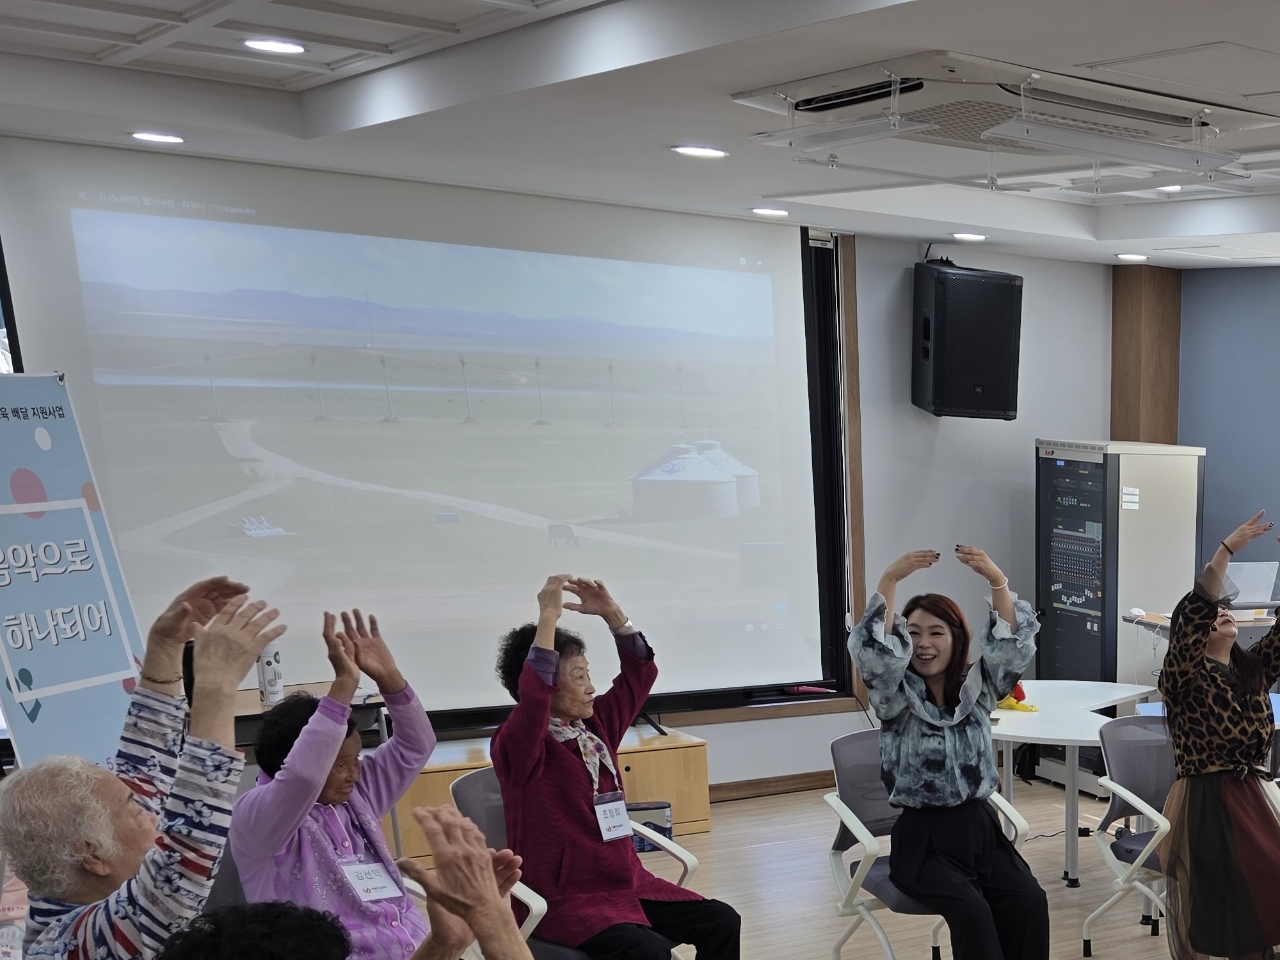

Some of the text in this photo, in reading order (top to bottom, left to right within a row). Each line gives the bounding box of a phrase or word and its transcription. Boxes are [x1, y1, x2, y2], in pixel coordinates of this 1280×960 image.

[11, 407, 30, 421] 배달
[31, 405, 65, 420] 지원사업
[2, 600, 112, 651] 하나되어
